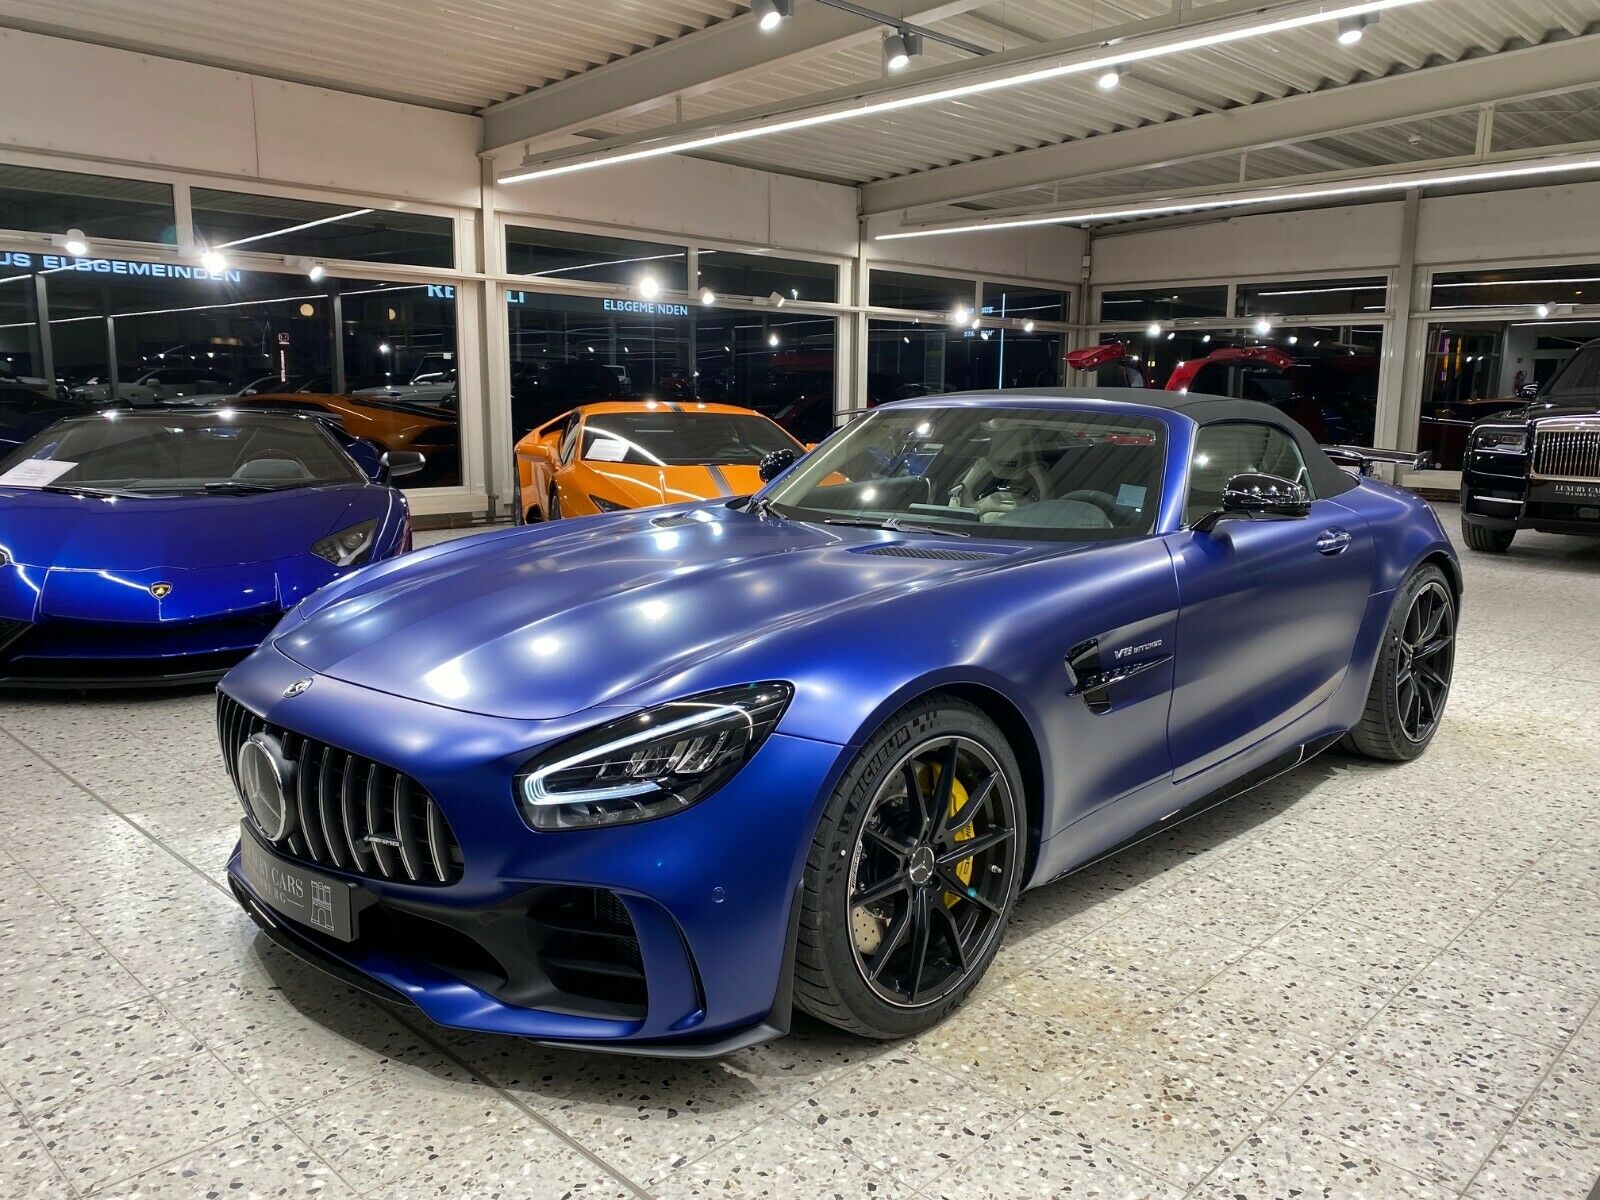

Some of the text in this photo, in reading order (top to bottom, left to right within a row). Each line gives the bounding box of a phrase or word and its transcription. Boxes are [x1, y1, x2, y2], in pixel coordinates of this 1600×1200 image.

[43, 255, 240, 282] ELBGEMEINDEN
[850, 725, 911, 811] MICHELIN
[271, 867, 304, 898] CARS
